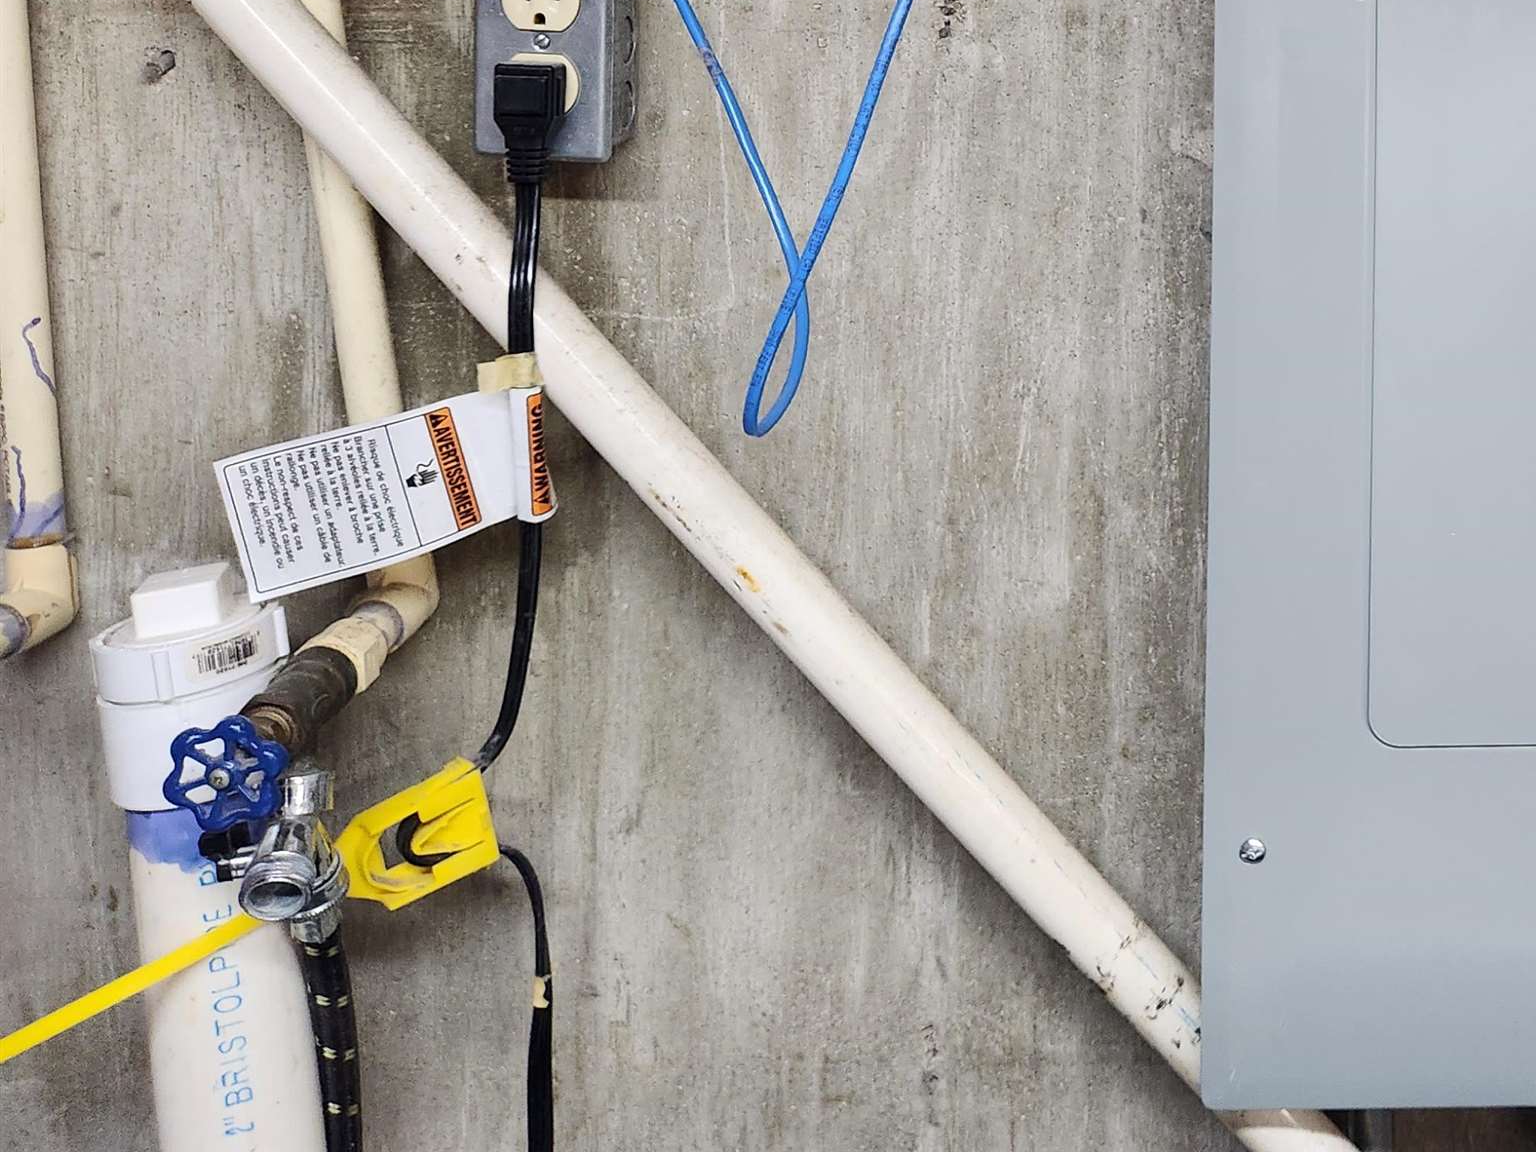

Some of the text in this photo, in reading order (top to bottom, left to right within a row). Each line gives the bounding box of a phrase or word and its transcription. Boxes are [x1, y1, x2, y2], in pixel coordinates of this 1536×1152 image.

[242, 478, 254, 500] choc
[248, 501, 266, 548] électrique.
[262, 458, 295, 563] instructions peut causer
[276, 468, 297, 521] non-respect
[293, 535, 304, 551] ces
[286, 452, 300, 491] rallonge.
[297, 463, 309, 480] pas
[304, 481, 318, 511] utiliser
[316, 526, 328, 550] câble
[309, 460, 321, 476] pas
[316, 477, 330, 506] utiliser
[321, 444, 332, 468] reliée
[331, 486, 343, 510] terre.
[332, 455, 344, 471] pas
[339, 473, 354, 504] enlever
[350, 513, 364, 544] broche
[346, 453, 362, 489] alvéoles
[357, 490, 369, 514] reliée
[369, 532, 380, 556] terre.
[353, 435, 386, 532] Brancher sur une prise
[368, 438, 381, 469] Risque
[379, 483, 391, 504] choc
[386, 506, 404, 547] électrique
[432, 426, 478, 525] AVERTISSEMENT
[265, 518, 281, 556] incendie
[203, 904, 255, 1110] BRISTOLPE
